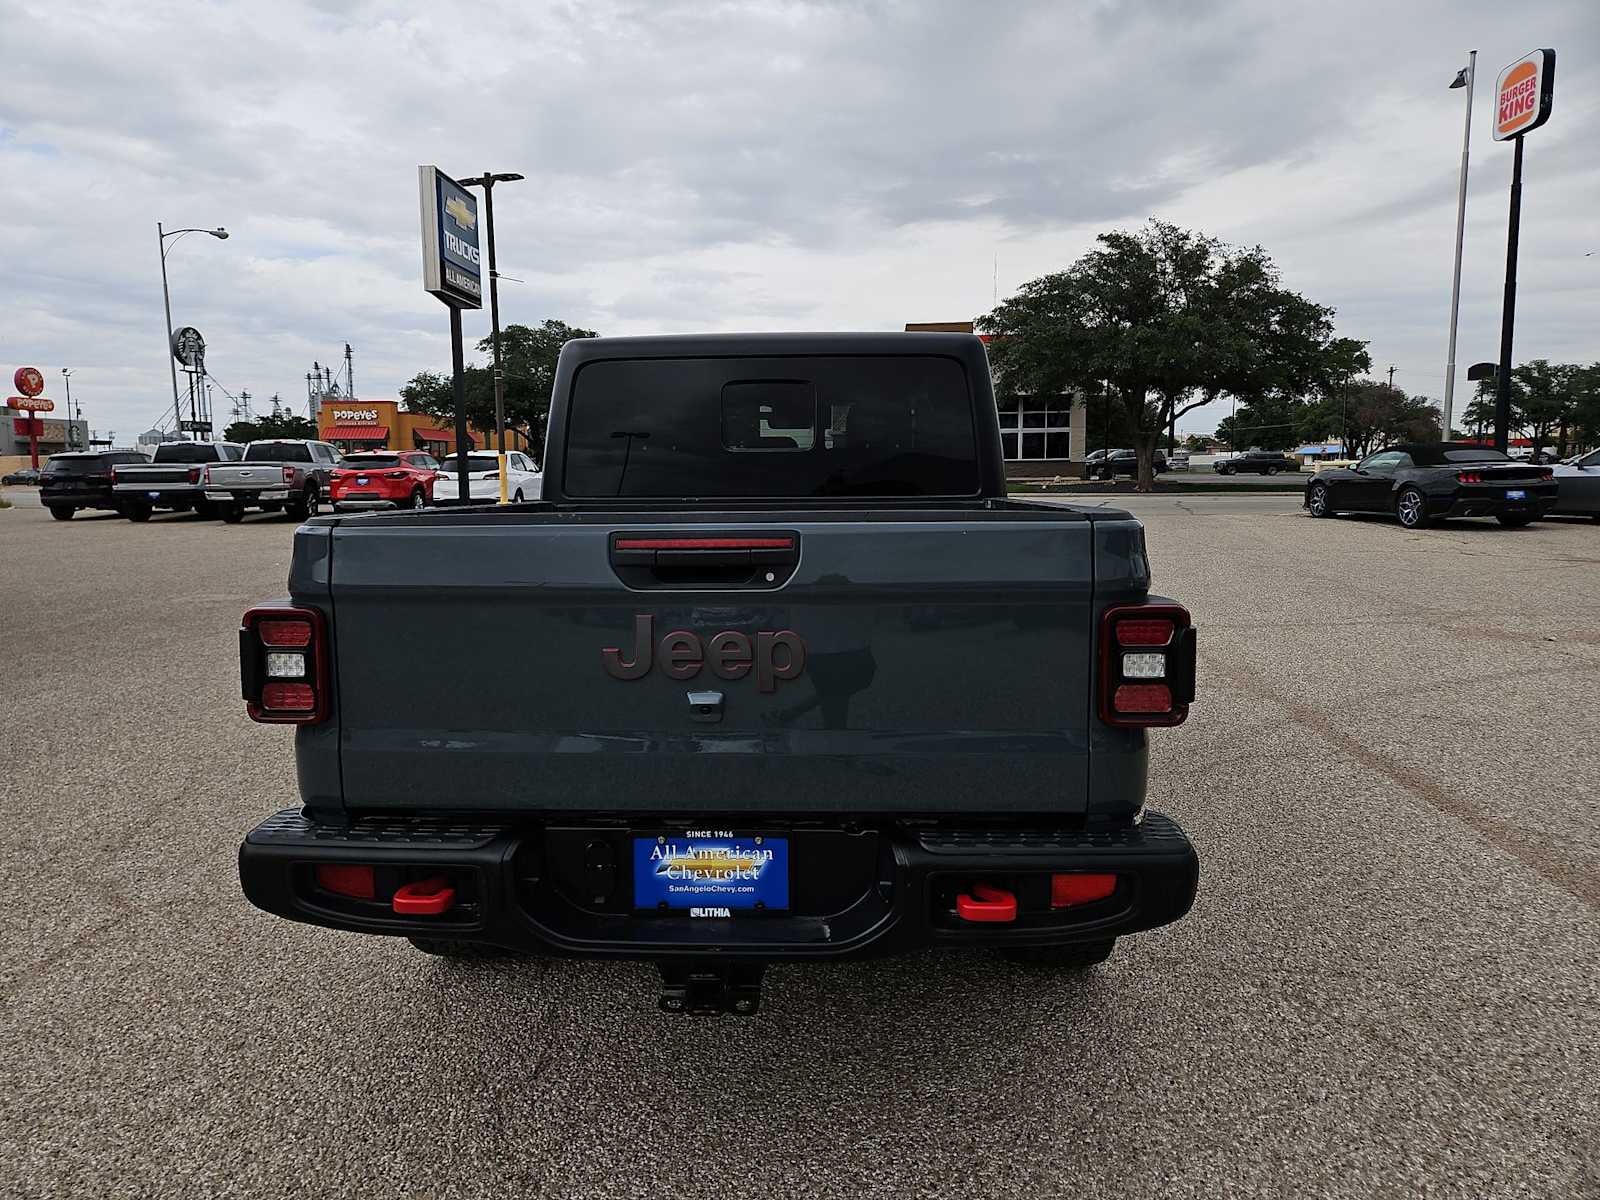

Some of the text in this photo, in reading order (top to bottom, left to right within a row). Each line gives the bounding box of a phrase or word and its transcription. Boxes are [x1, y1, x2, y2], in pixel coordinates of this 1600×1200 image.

[1500, 76, 1537, 106] BURGER
[1498, 91, 1535, 124] KING
[443, 230, 480, 265] TRUCKS
[602, 614, 807, 693] Jeep
[650, 845, 773, 860] All American
[667, 865, 759, 880] Chevrolet
[669, 885, 754, 893] SanAngeloChevy.com
[701, 908, 731, 917] LITHIA
